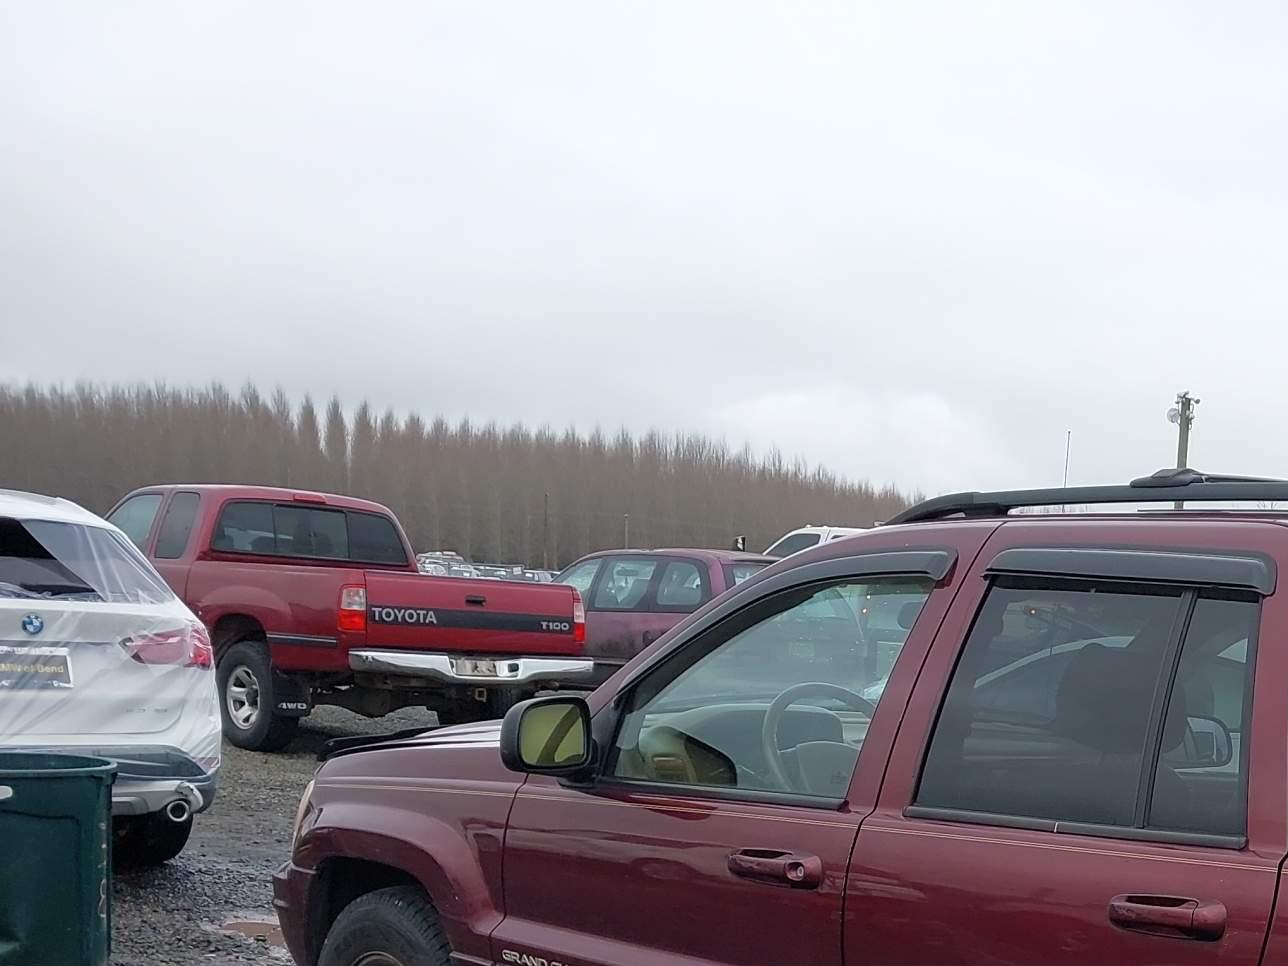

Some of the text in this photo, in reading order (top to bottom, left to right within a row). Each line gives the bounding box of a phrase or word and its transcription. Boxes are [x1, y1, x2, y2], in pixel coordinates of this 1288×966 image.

[371, 607, 437, 624] TOYOTA
[540, 621, 570, 631] T100
[277, 701, 308, 710] 4WD
